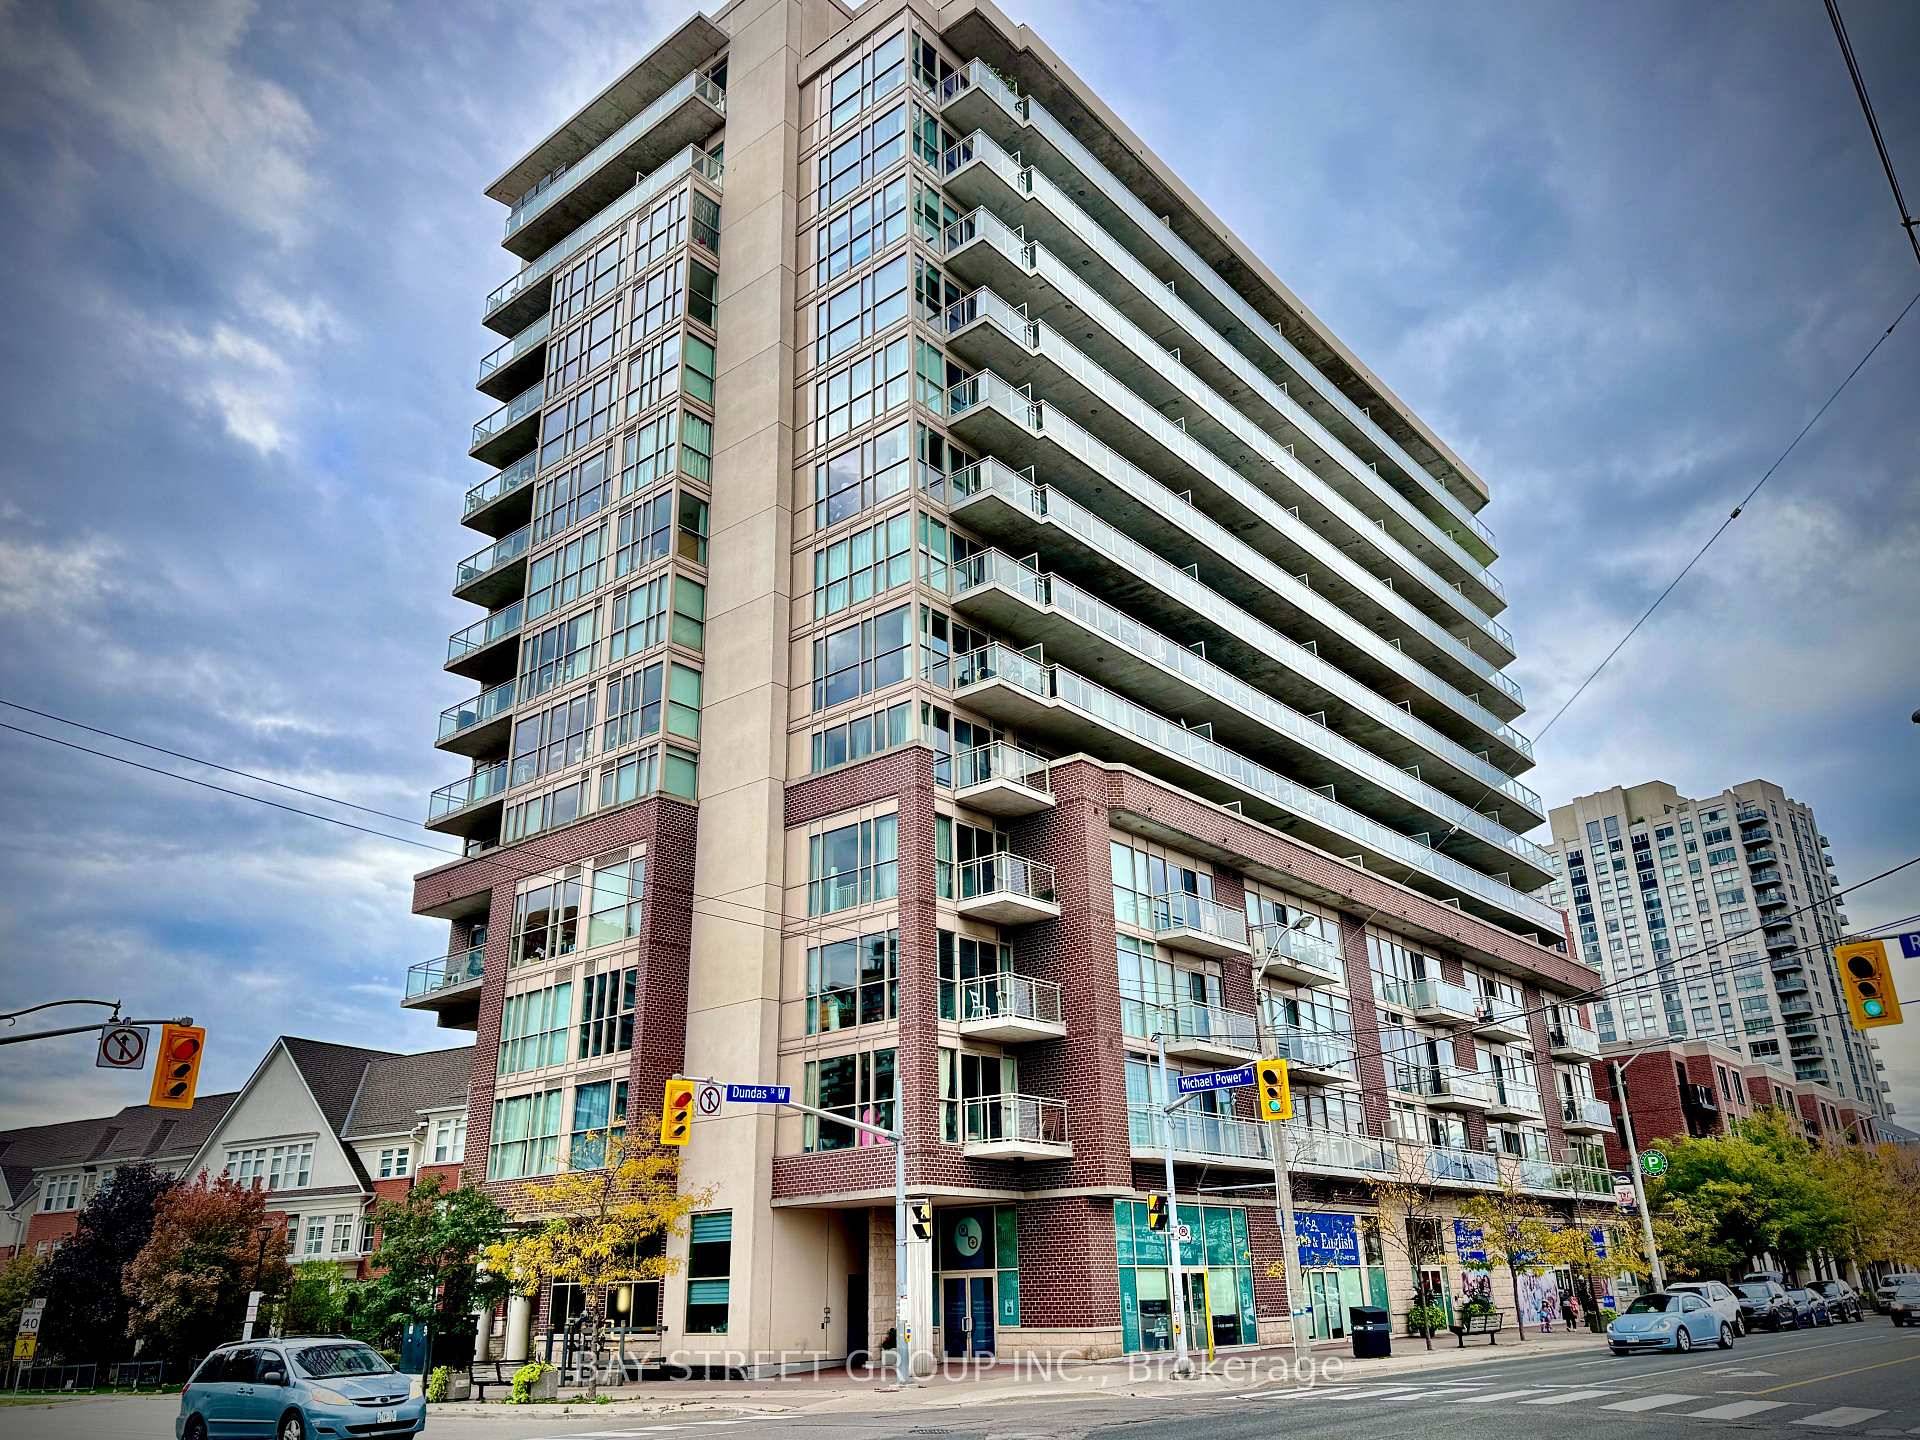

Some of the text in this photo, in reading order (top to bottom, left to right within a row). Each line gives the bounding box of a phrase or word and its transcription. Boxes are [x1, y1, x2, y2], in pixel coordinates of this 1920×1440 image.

[1181, 1075, 1213, 1090] Michael
[1215, 1073, 1242, 1086] Power
[732, 1085, 767, 1099] Dundas
[777, 1087, 786, 1100] W
[1648, 1156, 1659, 1168] P
[1320, 1232, 1355, 1251] English
[22, 1318, 38, 1329] 40
